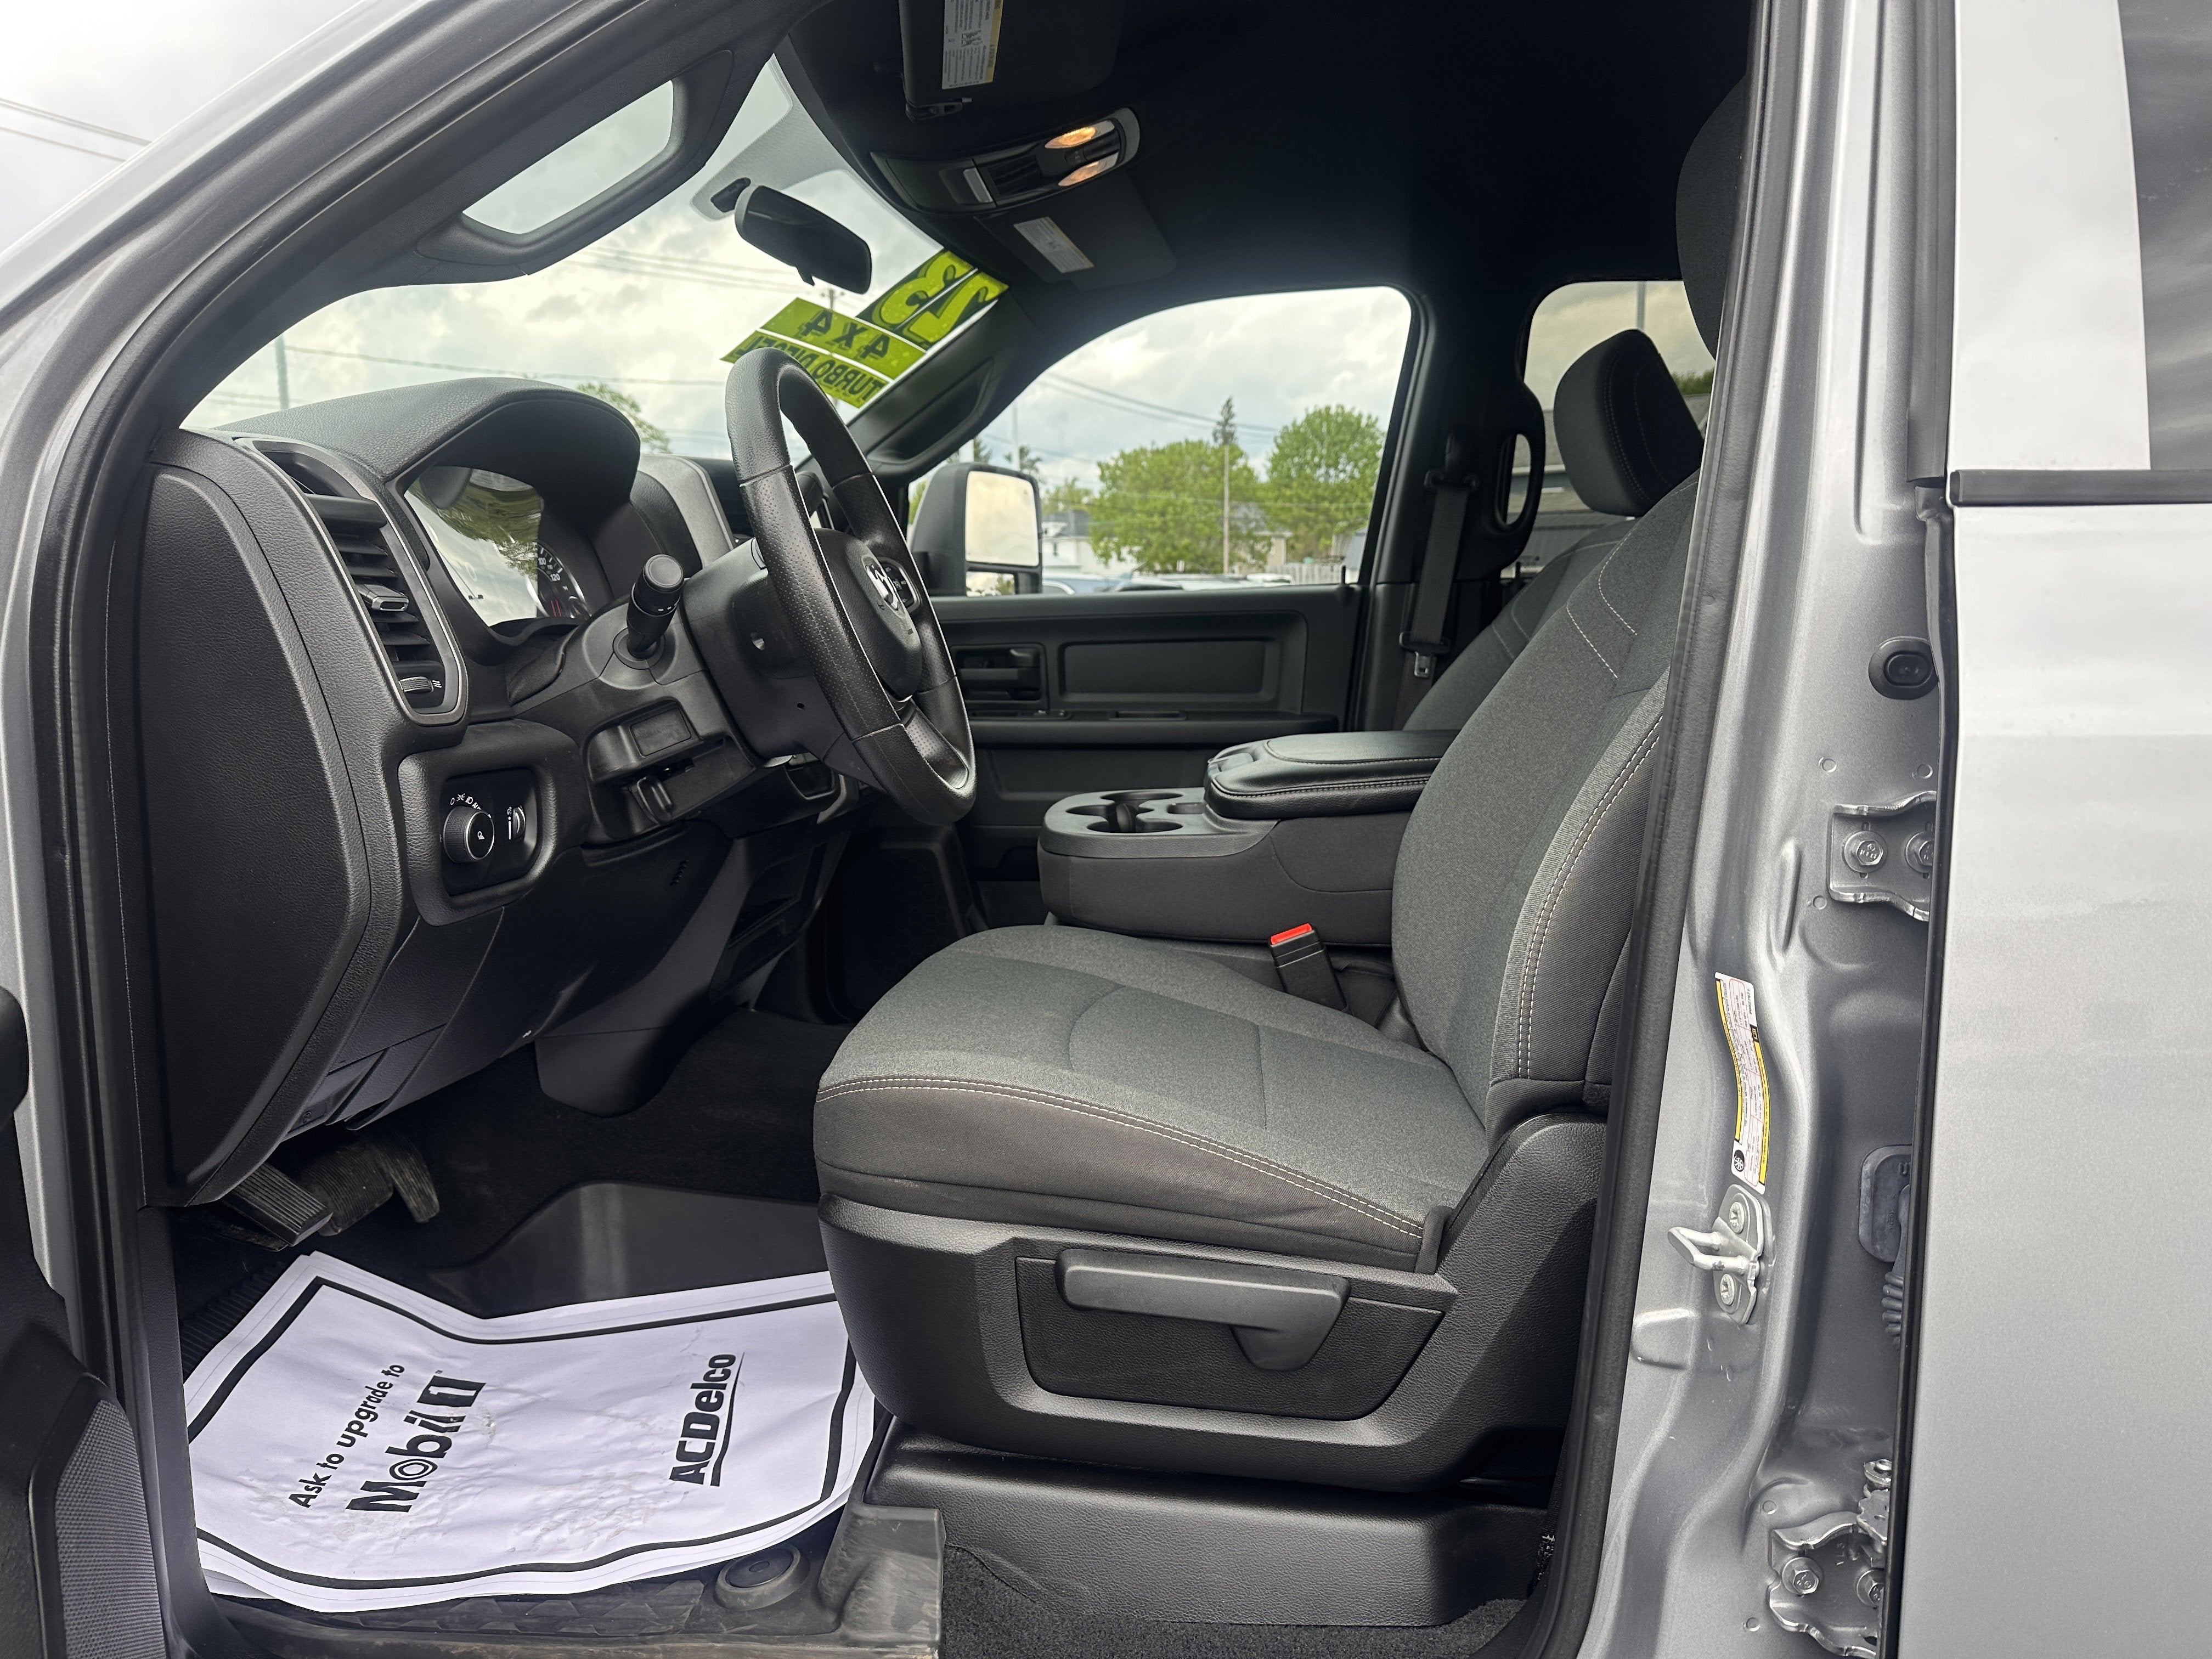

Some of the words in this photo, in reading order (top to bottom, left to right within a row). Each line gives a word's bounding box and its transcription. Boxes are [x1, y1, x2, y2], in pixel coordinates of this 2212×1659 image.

[289, 1472, 331, 1508] Ask
[316, 1453, 344, 1470] to
[336, 1381, 393, 1448] upgrade
[381, 1364, 405, 1378] to
[345, 1410, 466, 1513] Mobil
[669, 1354, 736, 1485] ACDelco
